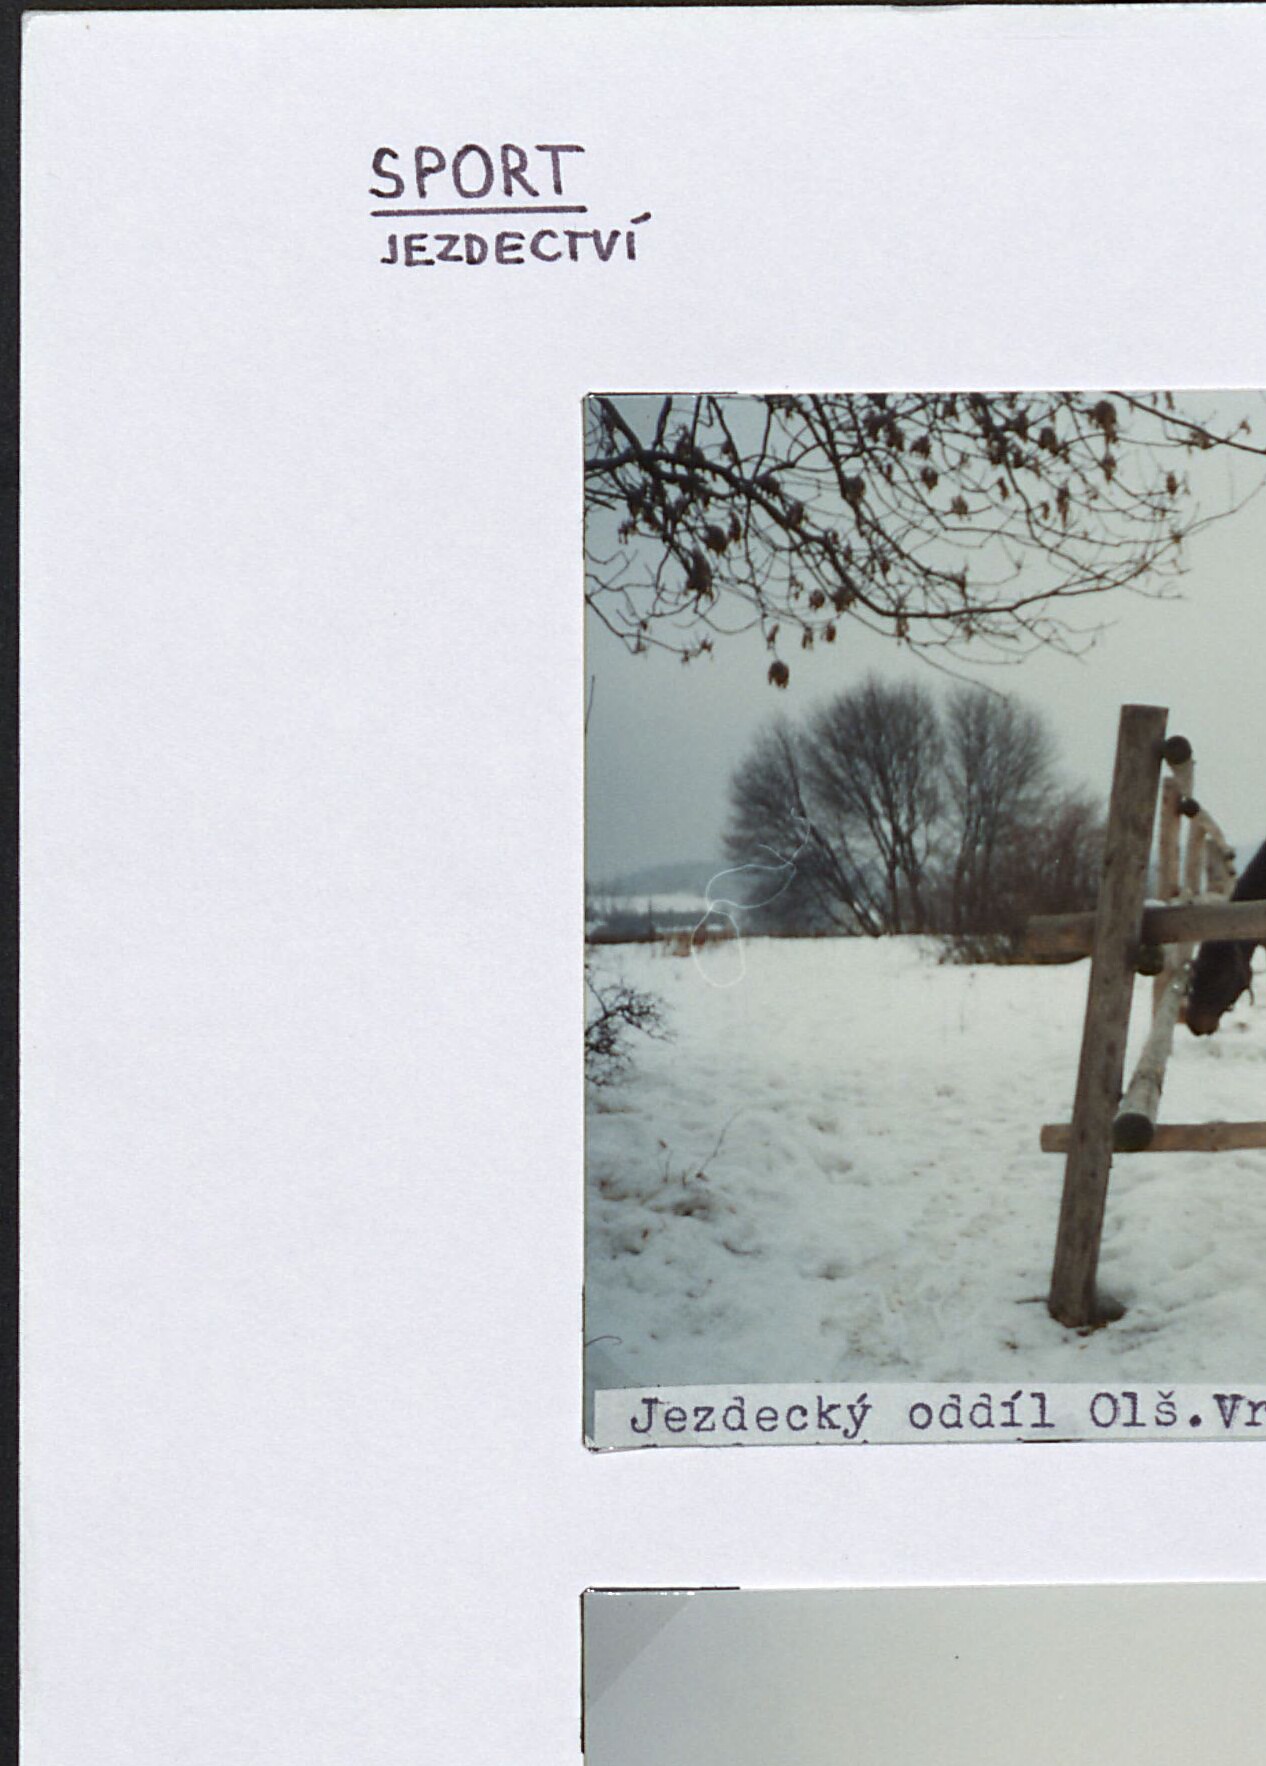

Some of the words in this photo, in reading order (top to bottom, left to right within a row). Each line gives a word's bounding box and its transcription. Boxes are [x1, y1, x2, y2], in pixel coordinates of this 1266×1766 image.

[369, 143, 586, 199] SPORT
[380, 211, 652, 267] JEZDECTVÍ
[630, 1392, 873, 1439] Jezdecký
[908, 1389, 1056, 1430] oddíl
